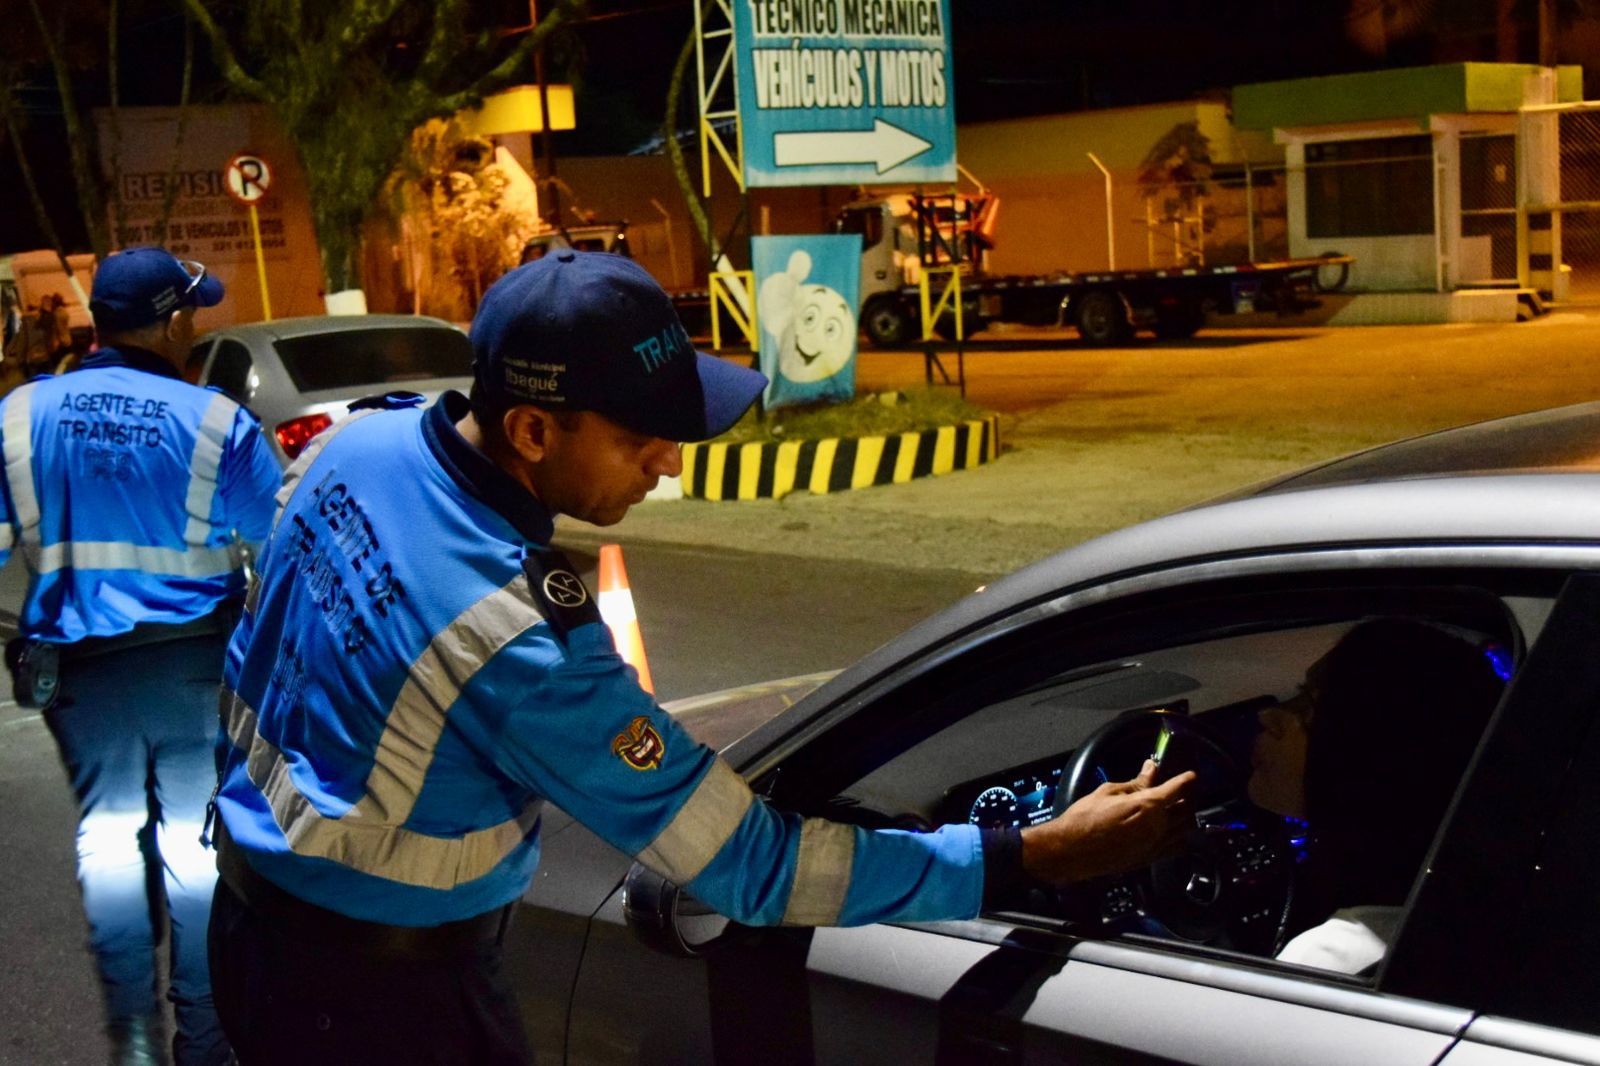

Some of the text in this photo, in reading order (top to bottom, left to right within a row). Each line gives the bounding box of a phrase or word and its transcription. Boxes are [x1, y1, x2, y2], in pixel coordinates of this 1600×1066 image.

[752, 37, 946, 109] VEHÍCULOS Y MOTOS
[239, 160, 263, 197] P
[504, 367, 560, 393] Ibagué
[59, 392, 170, 419] AGENTE DE
[58, 419, 162, 448] TRANSITO
